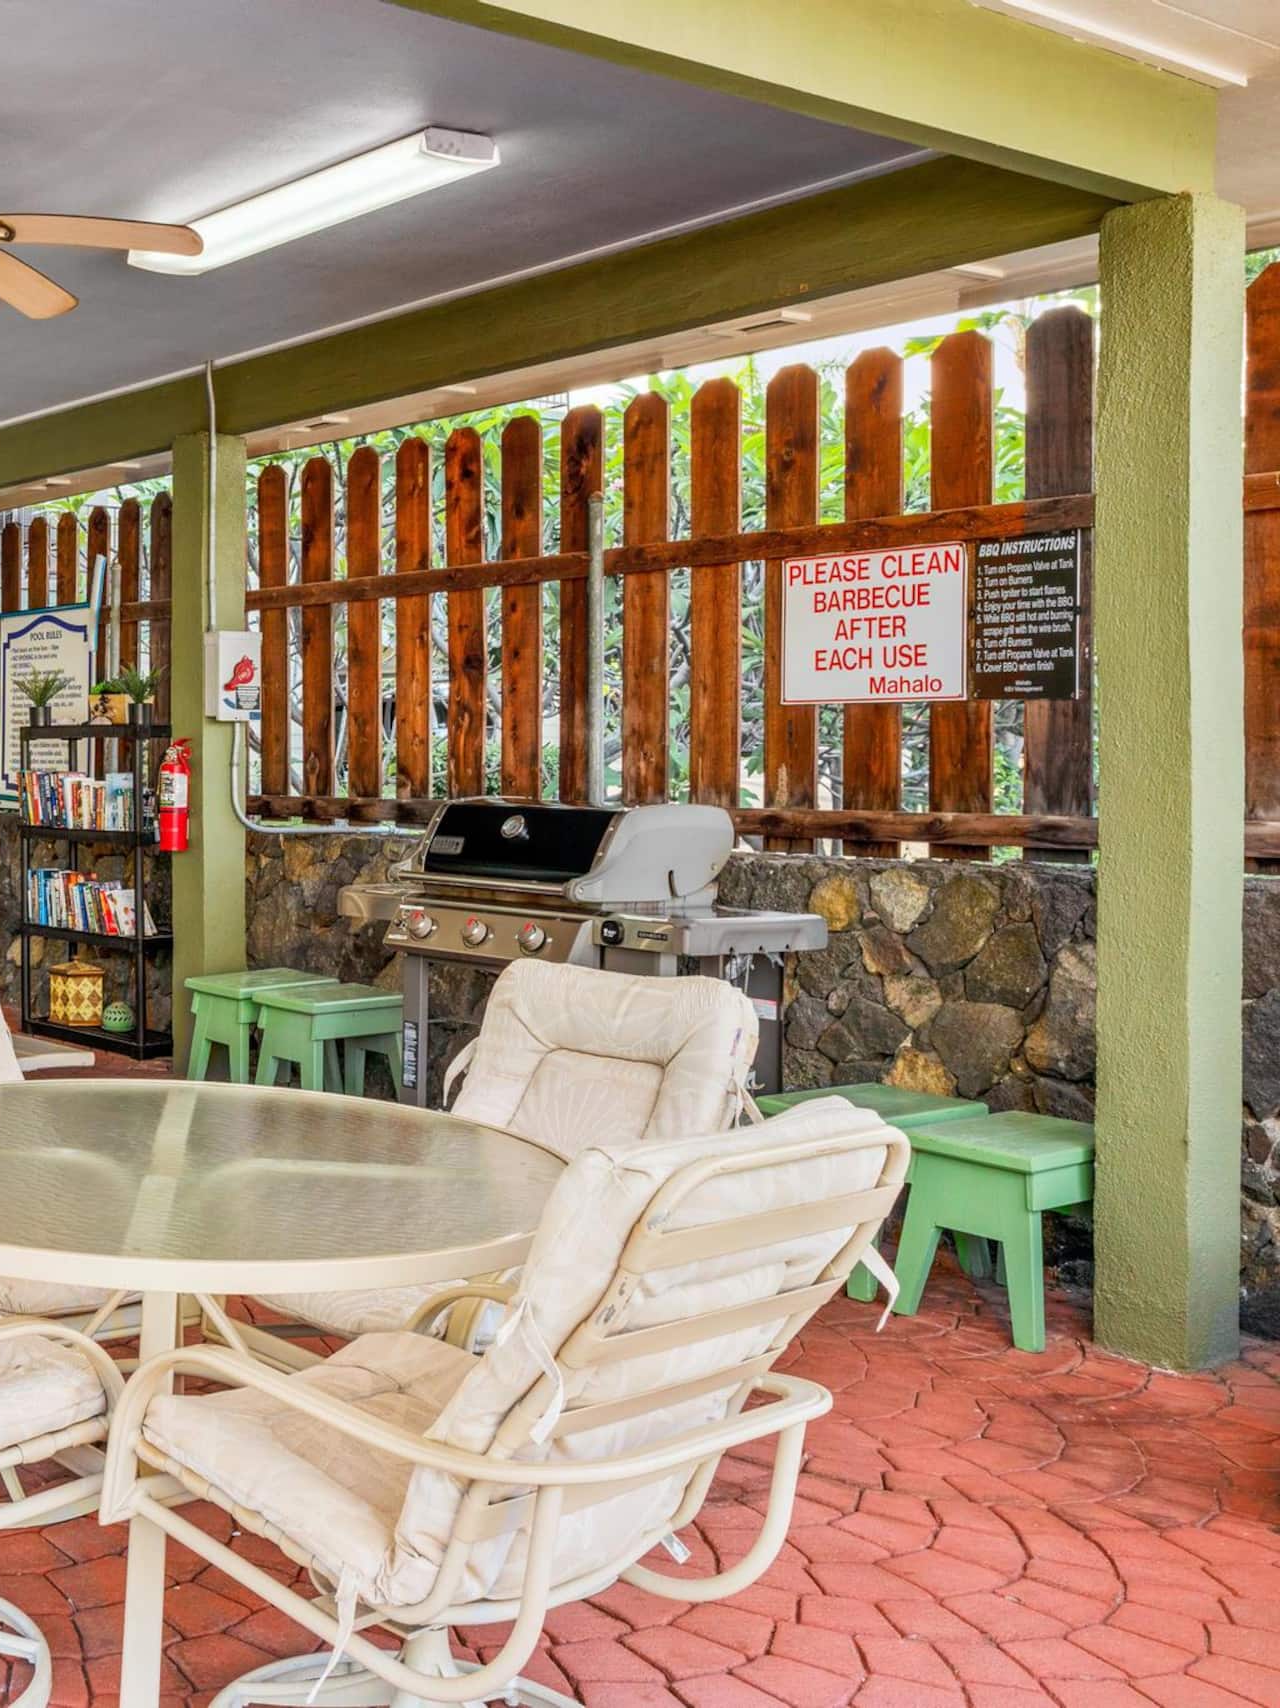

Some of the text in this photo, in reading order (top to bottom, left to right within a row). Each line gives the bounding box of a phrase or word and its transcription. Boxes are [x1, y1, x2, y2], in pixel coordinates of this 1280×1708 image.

[978, 536, 1076, 558] BBQ INSTRUCTIONS
[789, 550, 960, 586] PLEASE CLEAN
[984, 564, 998, 575] Turn
[998, 565, 1006, 574] on
[1007, 562, 1032, 574] Propane
[1033, 560, 1050, 570] Valve
[1051, 560, 1058, 570] at
[1058, 558, 1074, 569] Tank
[984, 577, 998, 588] Turn
[999, 578, 1008, 586] on
[1008, 575, 1033, 585] Burners
[814, 583, 931, 614] BARBECUE
[984, 588, 1000, 600] Push
[1002, 602, 1016, 612] your
[1046, 598, 1056, 608] the
[1057, 596, 1074, 607] BBQ
[1027, 611, 1036, 621] hot
[834, 615, 906, 641] AFTER
[1028, 624, 1038, 634] the
[30, 632, 44, 642] POOL
[984, 638, 998, 648] Turn
[998, 637, 1008, 648] off
[1008, 637, 1032, 648] Burners
[814, 644, 928, 672] EACH USE
[984, 650, 997, 660] Turn
[998, 650, 1006, 660] off
[1007, 650, 1032, 662] Propane
[1033, 648, 1050, 658] Valve
[1051, 648, 1058, 658] at
[1058, 647, 1074, 658] Tank
[984, 662, 1002, 672] Cover
[1003, 662, 1018, 672] BBQ
[1019, 660, 1036, 671] when
[1037, 660, 1054, 671] finish
[870, 674, 942, 694] Mahalo
